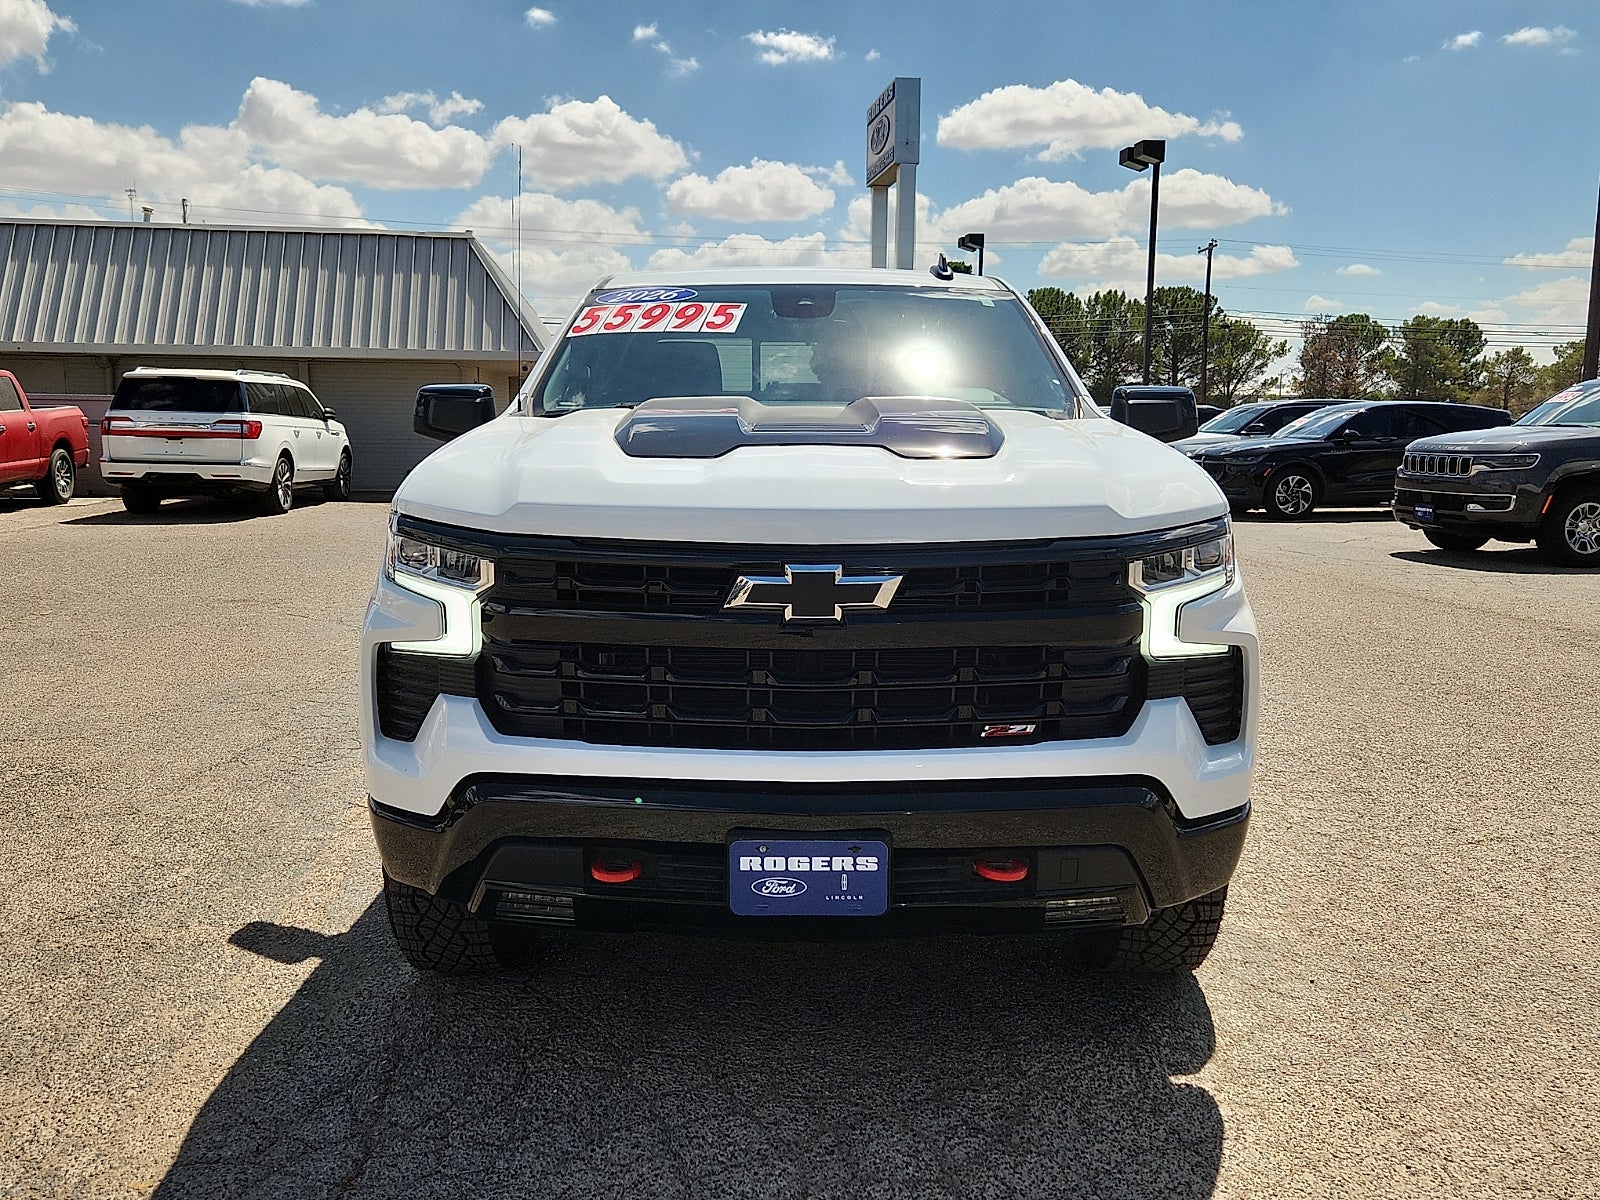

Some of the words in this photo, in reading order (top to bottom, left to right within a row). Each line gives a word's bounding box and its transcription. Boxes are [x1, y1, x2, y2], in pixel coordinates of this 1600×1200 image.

[611, 288, 676, 303] 2026
[571, 303, 743, 334] 55995
[980, 724, 1037, 738] Z71
[739, 856, 879, 872] ROGERS
[761, 879, 797, 895] Ford
